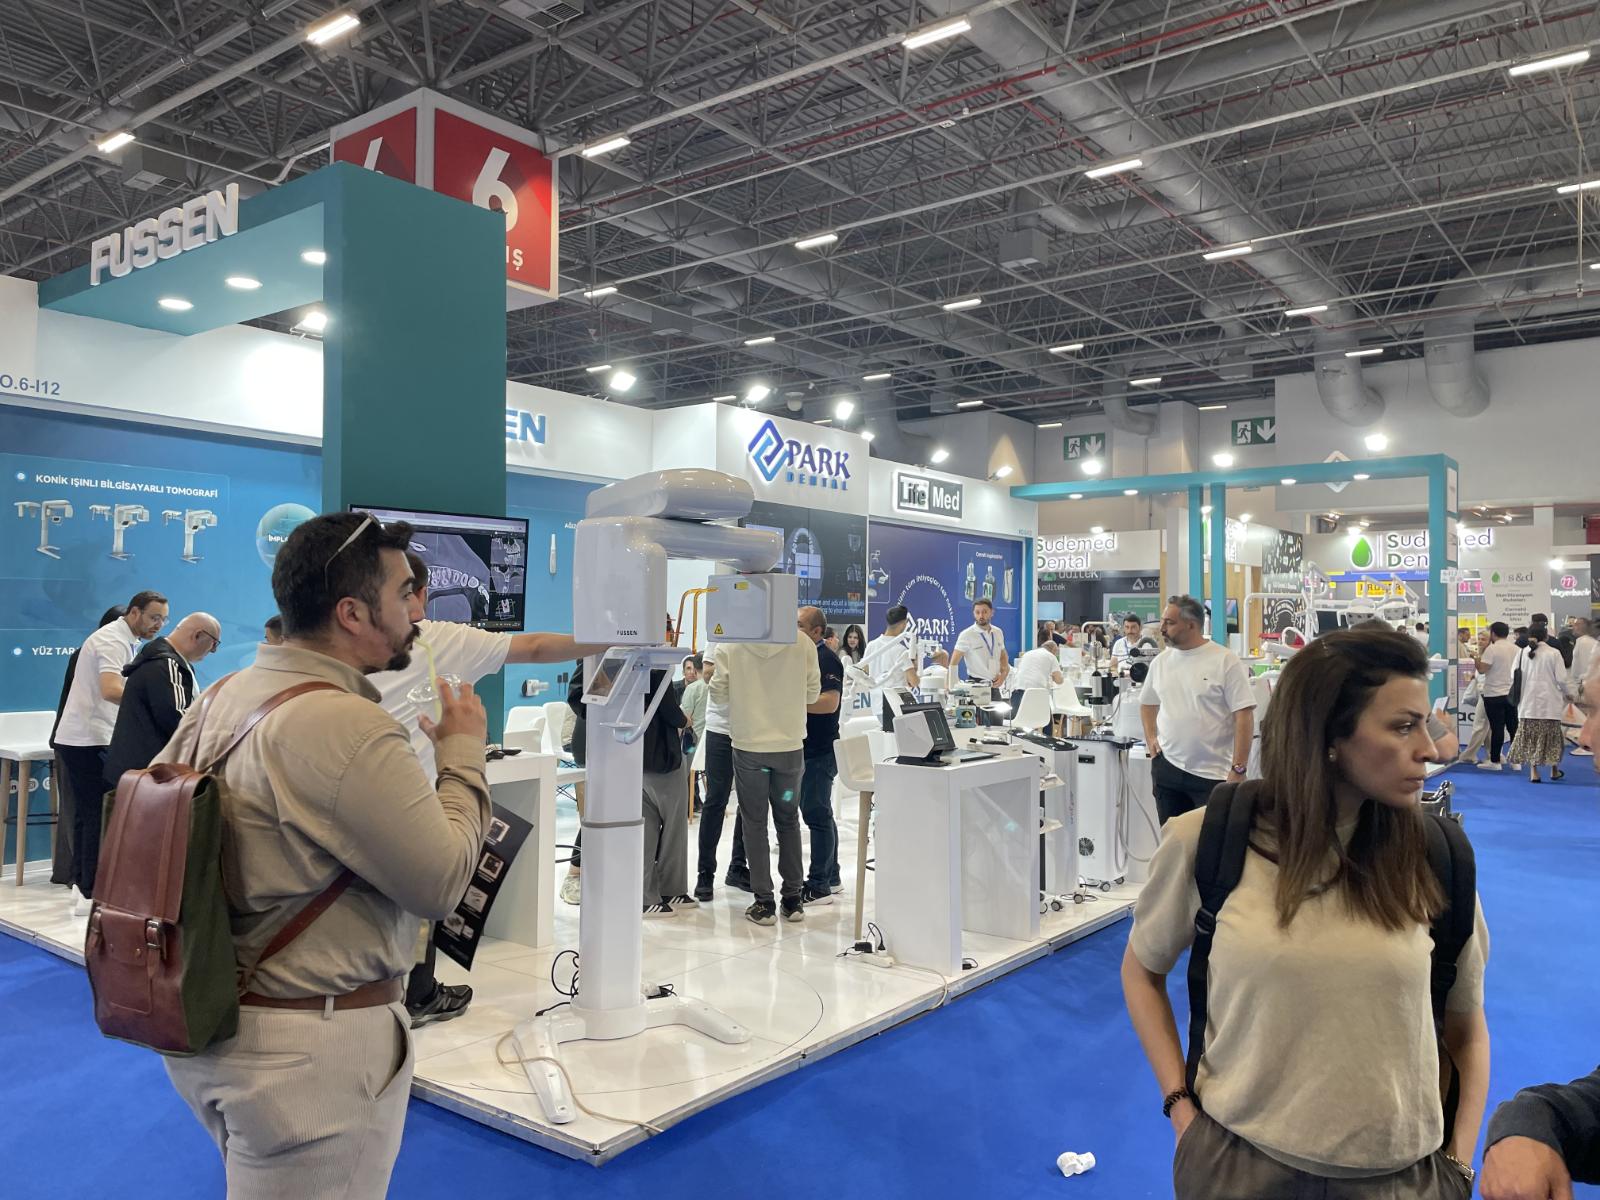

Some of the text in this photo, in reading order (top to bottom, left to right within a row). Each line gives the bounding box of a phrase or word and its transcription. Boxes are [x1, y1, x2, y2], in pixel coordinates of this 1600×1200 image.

[90, 183, 239, 286] FUSSEN
[786, 439, 850, 479] PARK
[36, 474, 218, 498] KONİK IŞINLI BİLGİSAYARLI TOMOGRAFİ
[786, 471, 848, 491] DENTAL
[932, 485, 960, 511] Med
[1037, 532, 1116, 552] Sudemed
[1387, 528, 1492, 548] Suded
[1037, 552, 1089, 569] Dental
[917, 618, 949, 635] PARK
[31, 645, 53, 656] YÜZ
